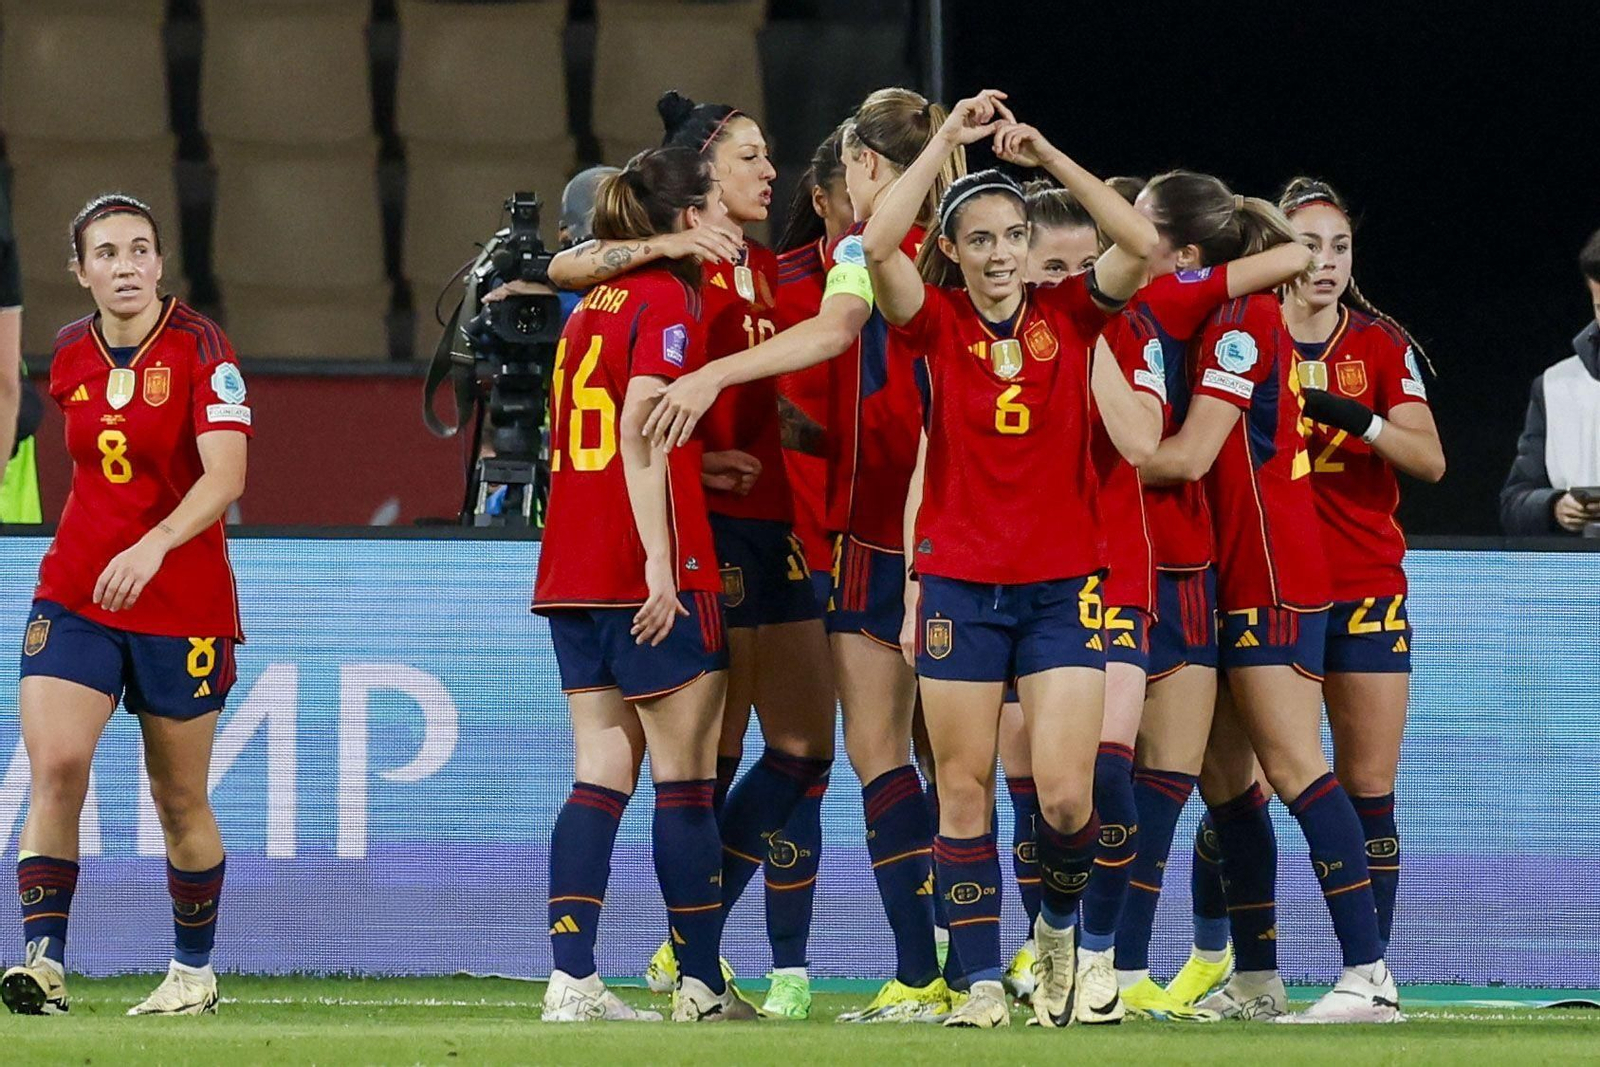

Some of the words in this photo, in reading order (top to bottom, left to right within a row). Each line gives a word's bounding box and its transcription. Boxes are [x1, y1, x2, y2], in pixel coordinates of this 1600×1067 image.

[551, 335, 617, 472] 16
[995, 384, 1030, 434] 6
[97, 430, 132, 483] 8
[1078, 575, 1102, 629] 6
[1348, 594, 1406, 634] 22
[187, 637, 216, 678] 8
